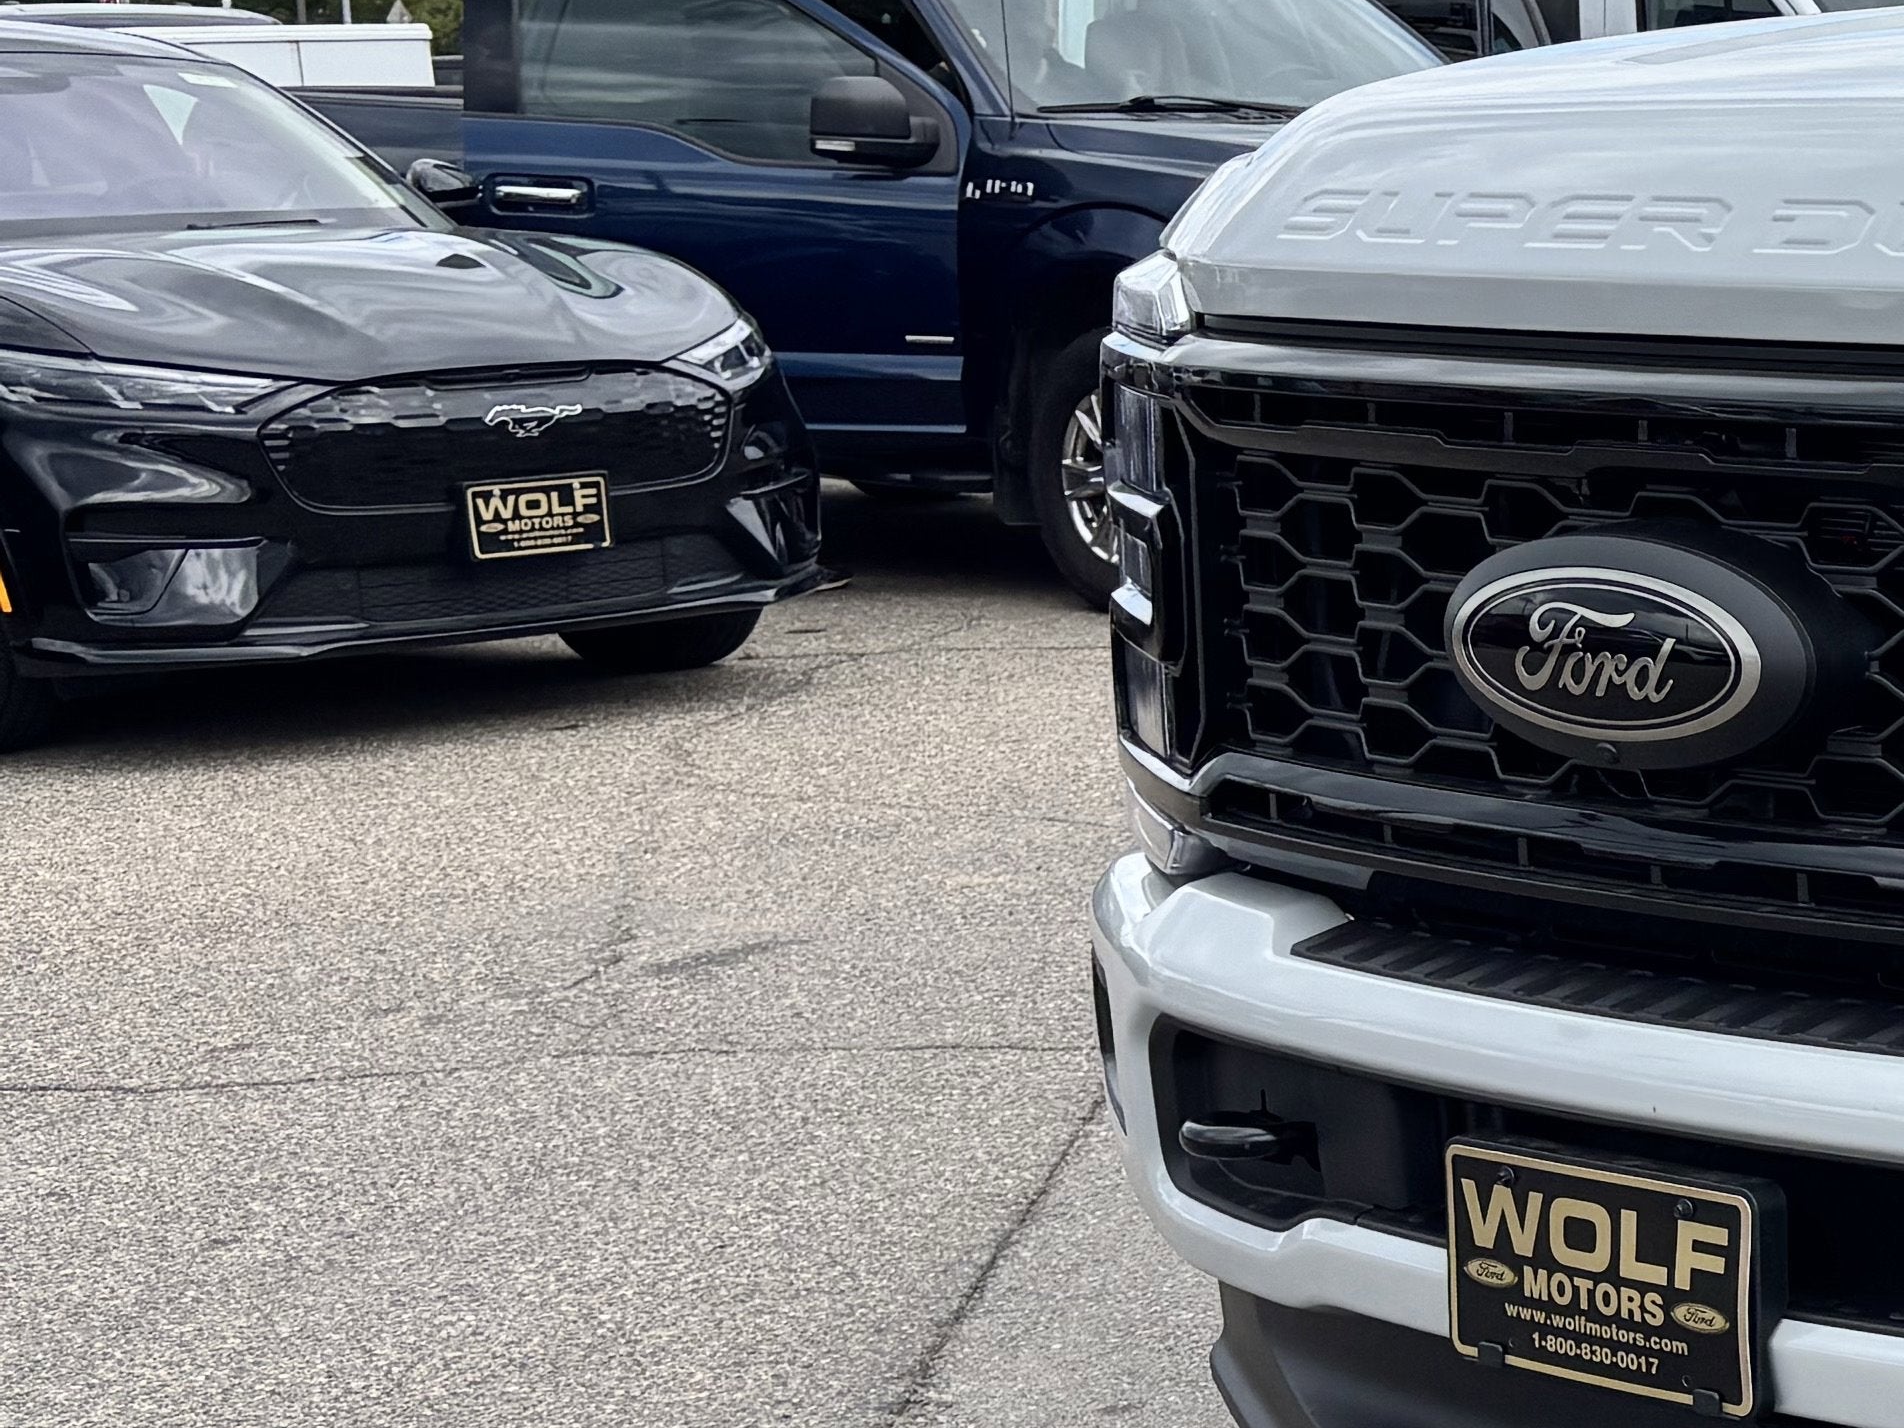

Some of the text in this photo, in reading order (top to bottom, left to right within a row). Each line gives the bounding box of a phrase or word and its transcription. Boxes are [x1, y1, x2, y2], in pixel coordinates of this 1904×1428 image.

[1275, 188, 1735, 252] SUPER
[475, 487, 598, 521] WOLF
[506, 514, 574, 532] MOTORS
[1515, 601, 1677, 704] Ford
[1460, 1178, 1730, 1292] WOLF
[1474, 1260, 1507, 1284] Ford
[1523, 1264, 1665, 1327] MOTORS
[1504, 1302, 1689, 1356] www.wolfmotors.com
[1683, 1309, 1716, 1329] Ford
[1531, 1331, 1660, 1375] 1-800-830-0017
